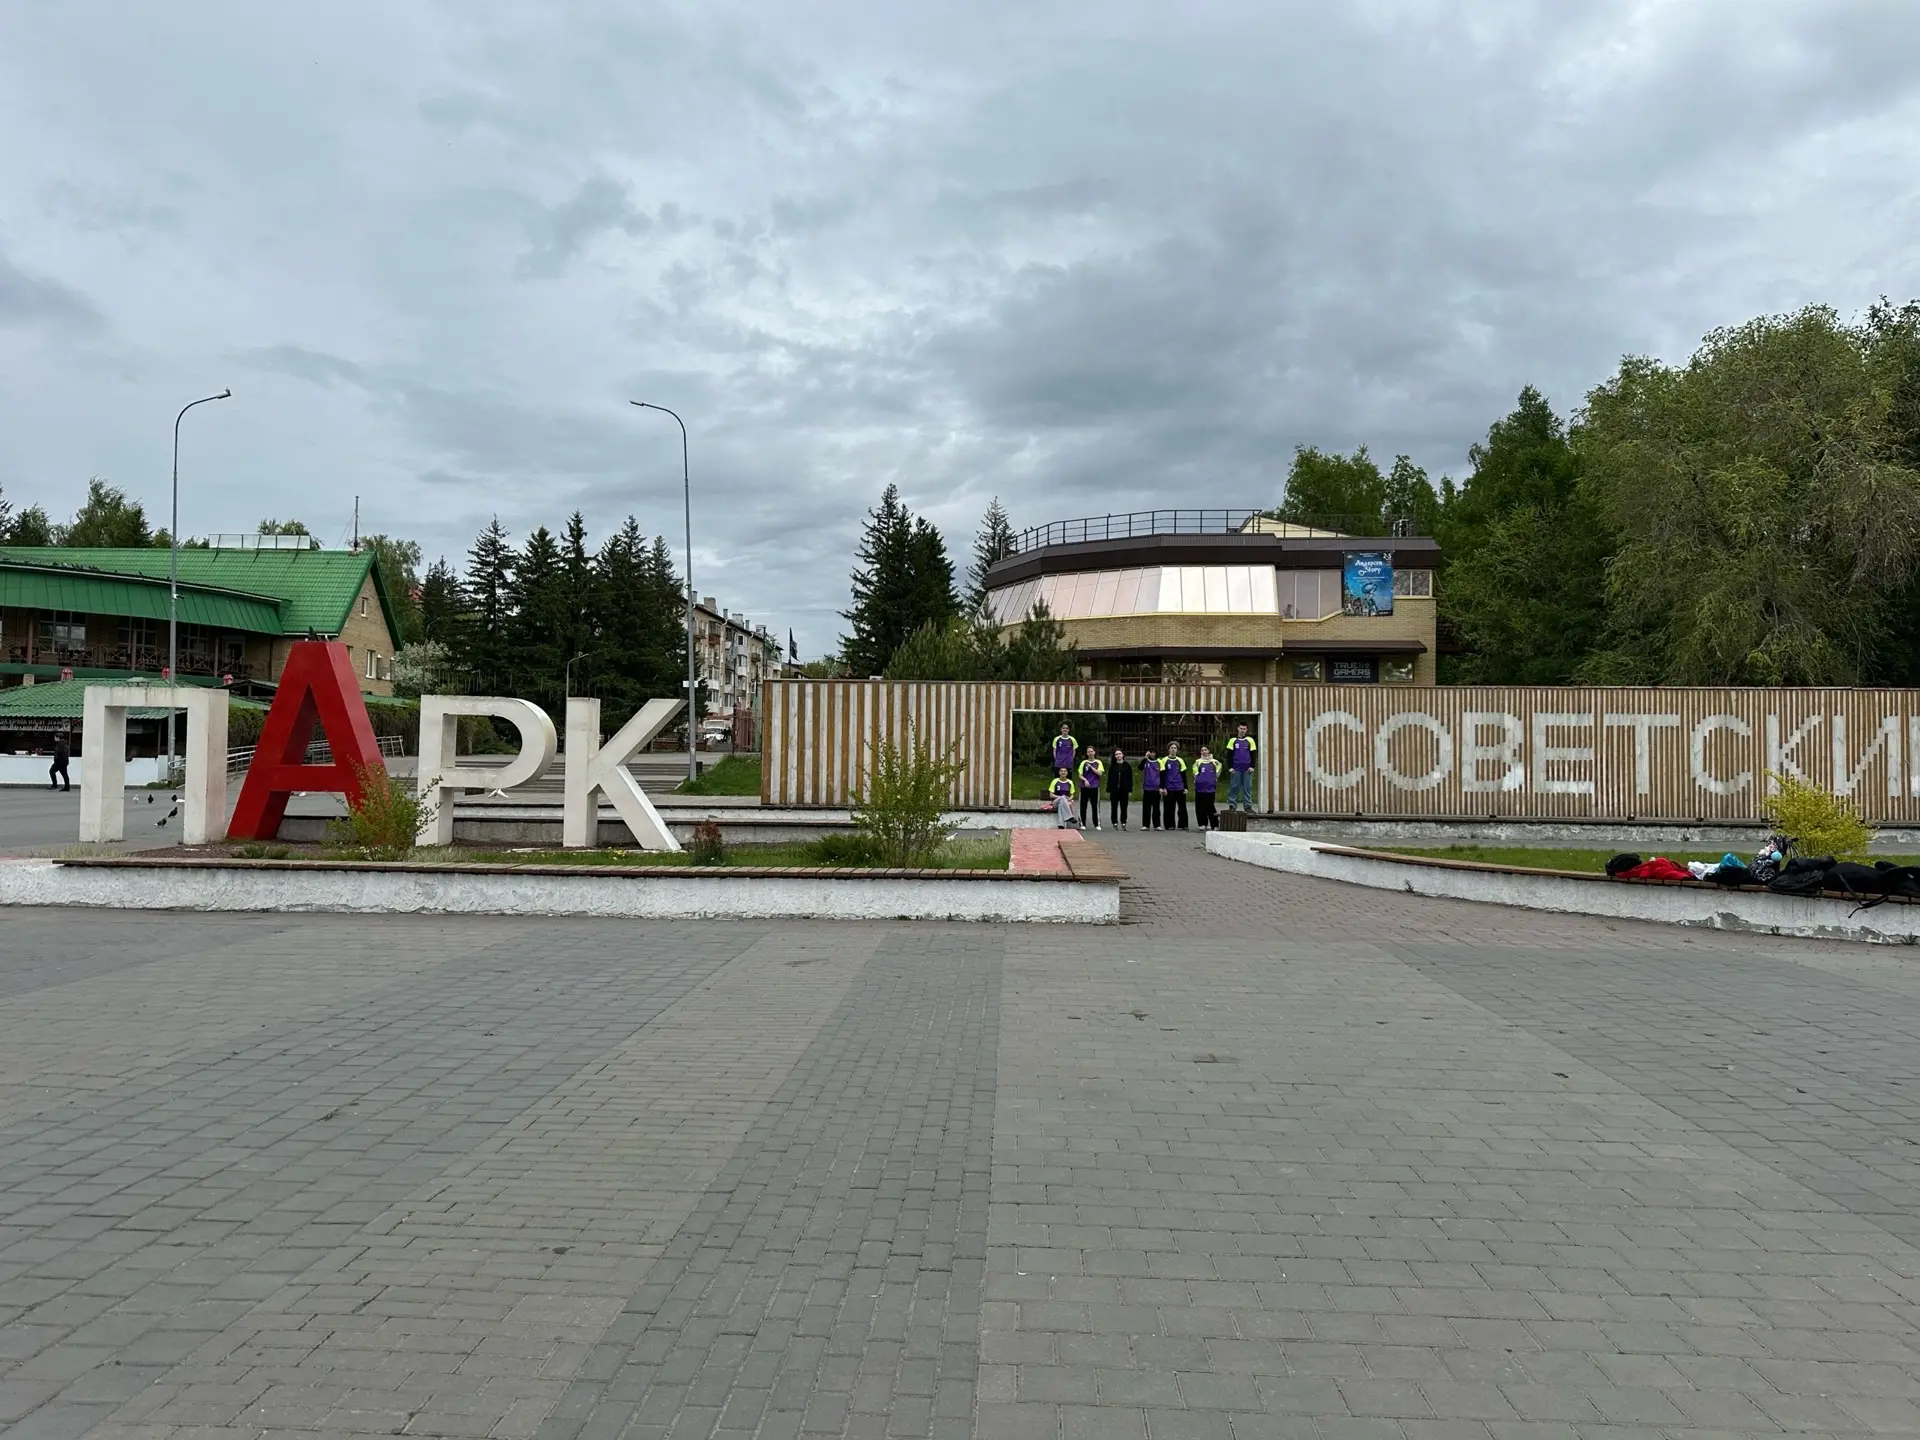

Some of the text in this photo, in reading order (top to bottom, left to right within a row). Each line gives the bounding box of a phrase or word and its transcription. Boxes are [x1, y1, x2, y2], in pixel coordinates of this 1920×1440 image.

[1333, 668, 1371, 676] GAMERS
[81, 641, 687, 852] ПАРК
[1305, 710, 1920, 797] СОВЕТСКИ
